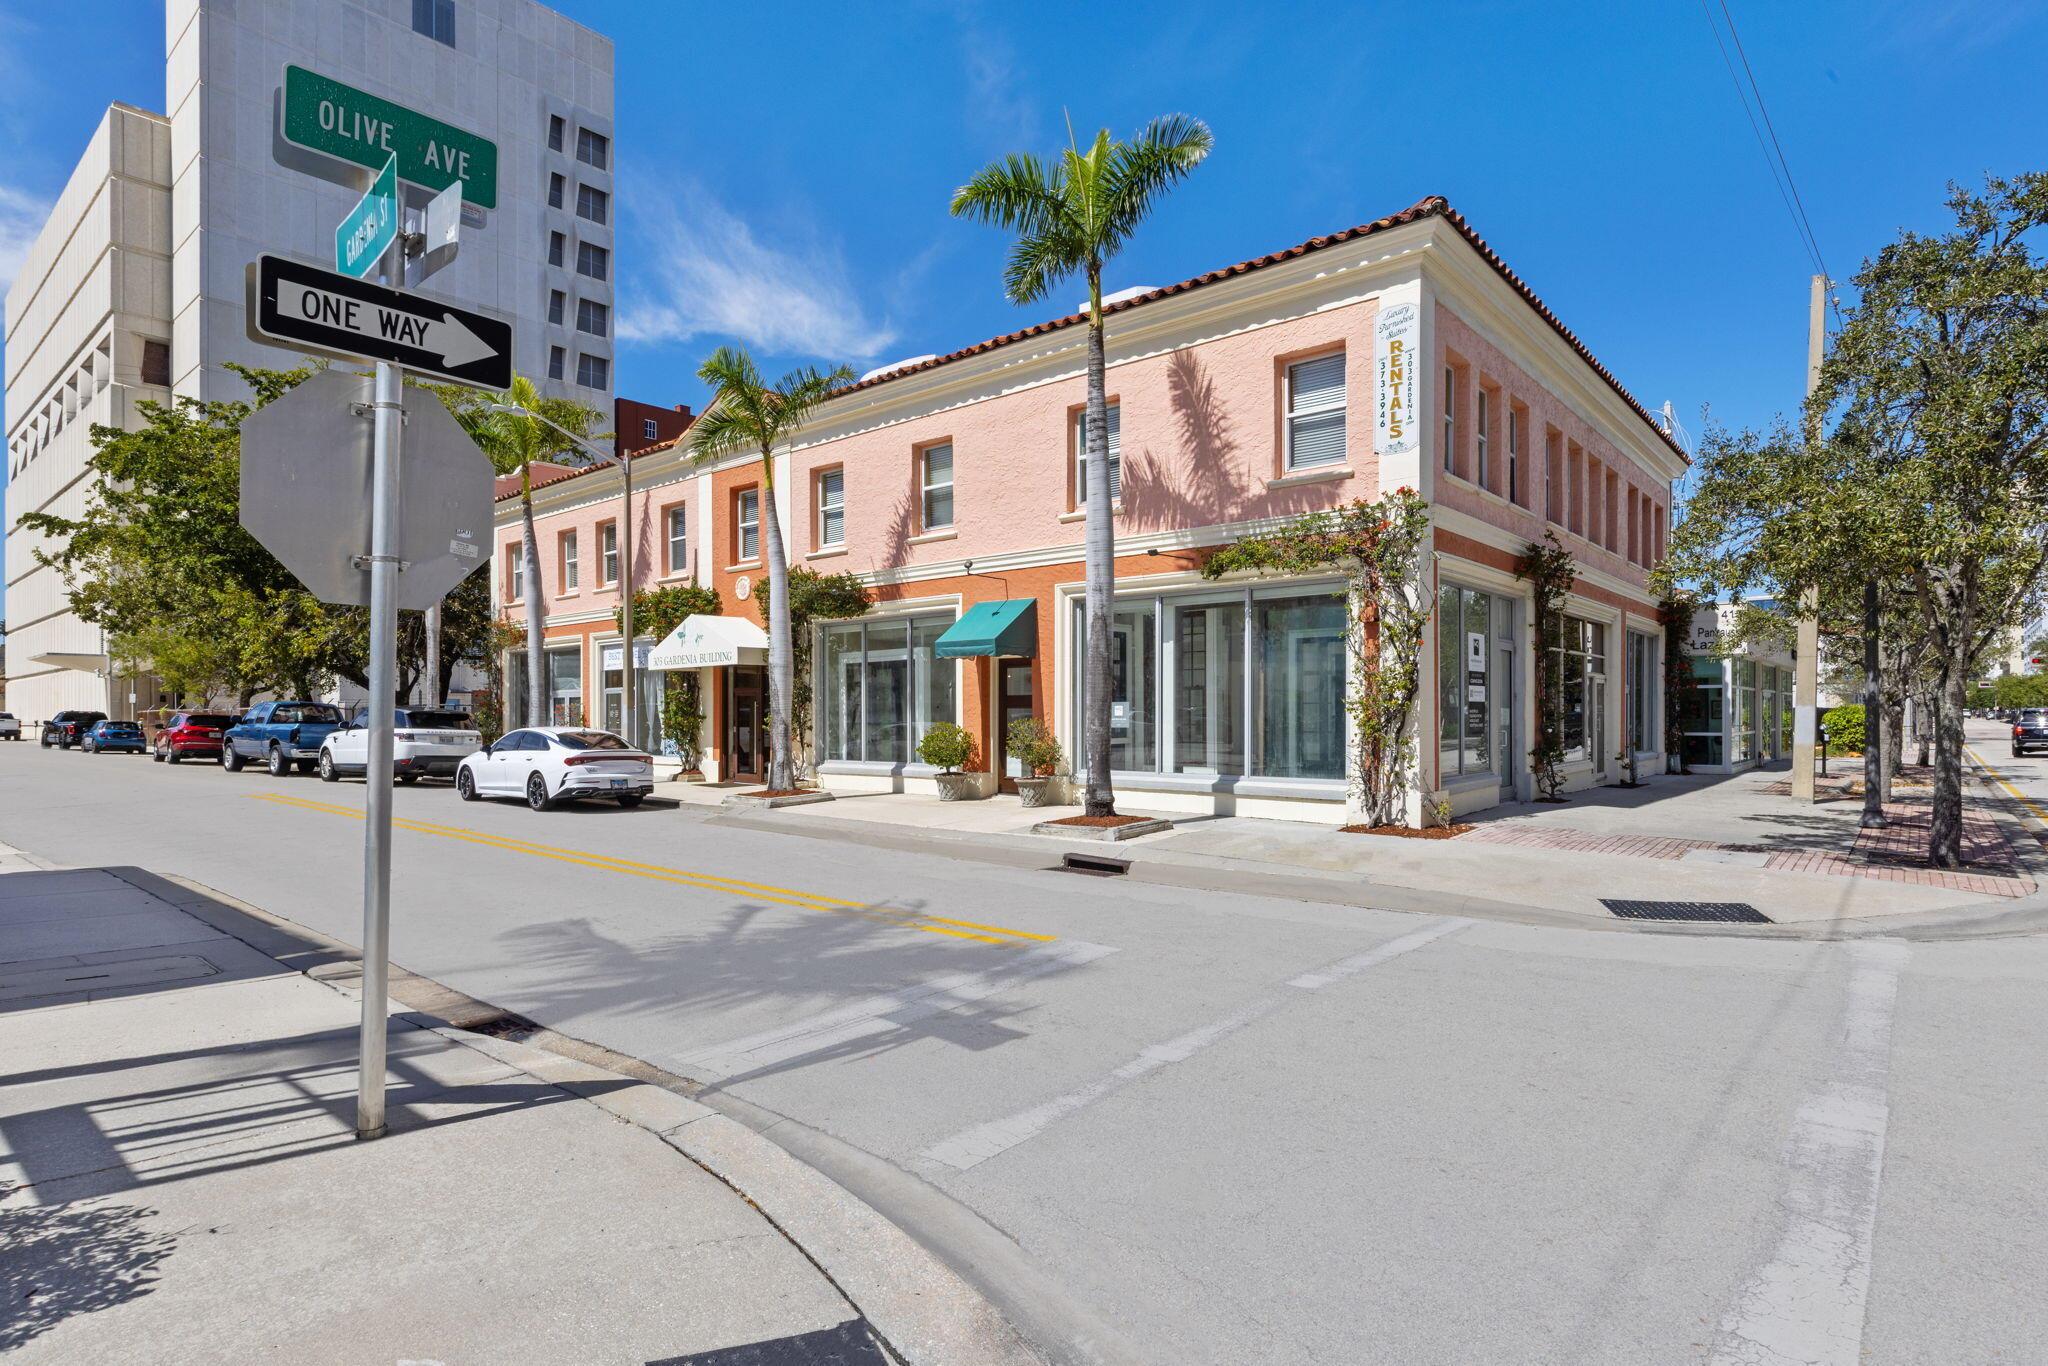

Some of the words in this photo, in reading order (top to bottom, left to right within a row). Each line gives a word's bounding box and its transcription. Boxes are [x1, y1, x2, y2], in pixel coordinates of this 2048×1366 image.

[318, 100, 394, 152] OLIVE
[424, 140, 471, 181] AVE
[380, 191, 388, 228] ST
[301, 289, 361, 331] ONE
[378, 309, 430, 347] WAY
[1389, 340, 1404, 439] RENTALS
[664, 653, 697, 666] GARDENIA
[699, 651, 733, 664] BUILDING
